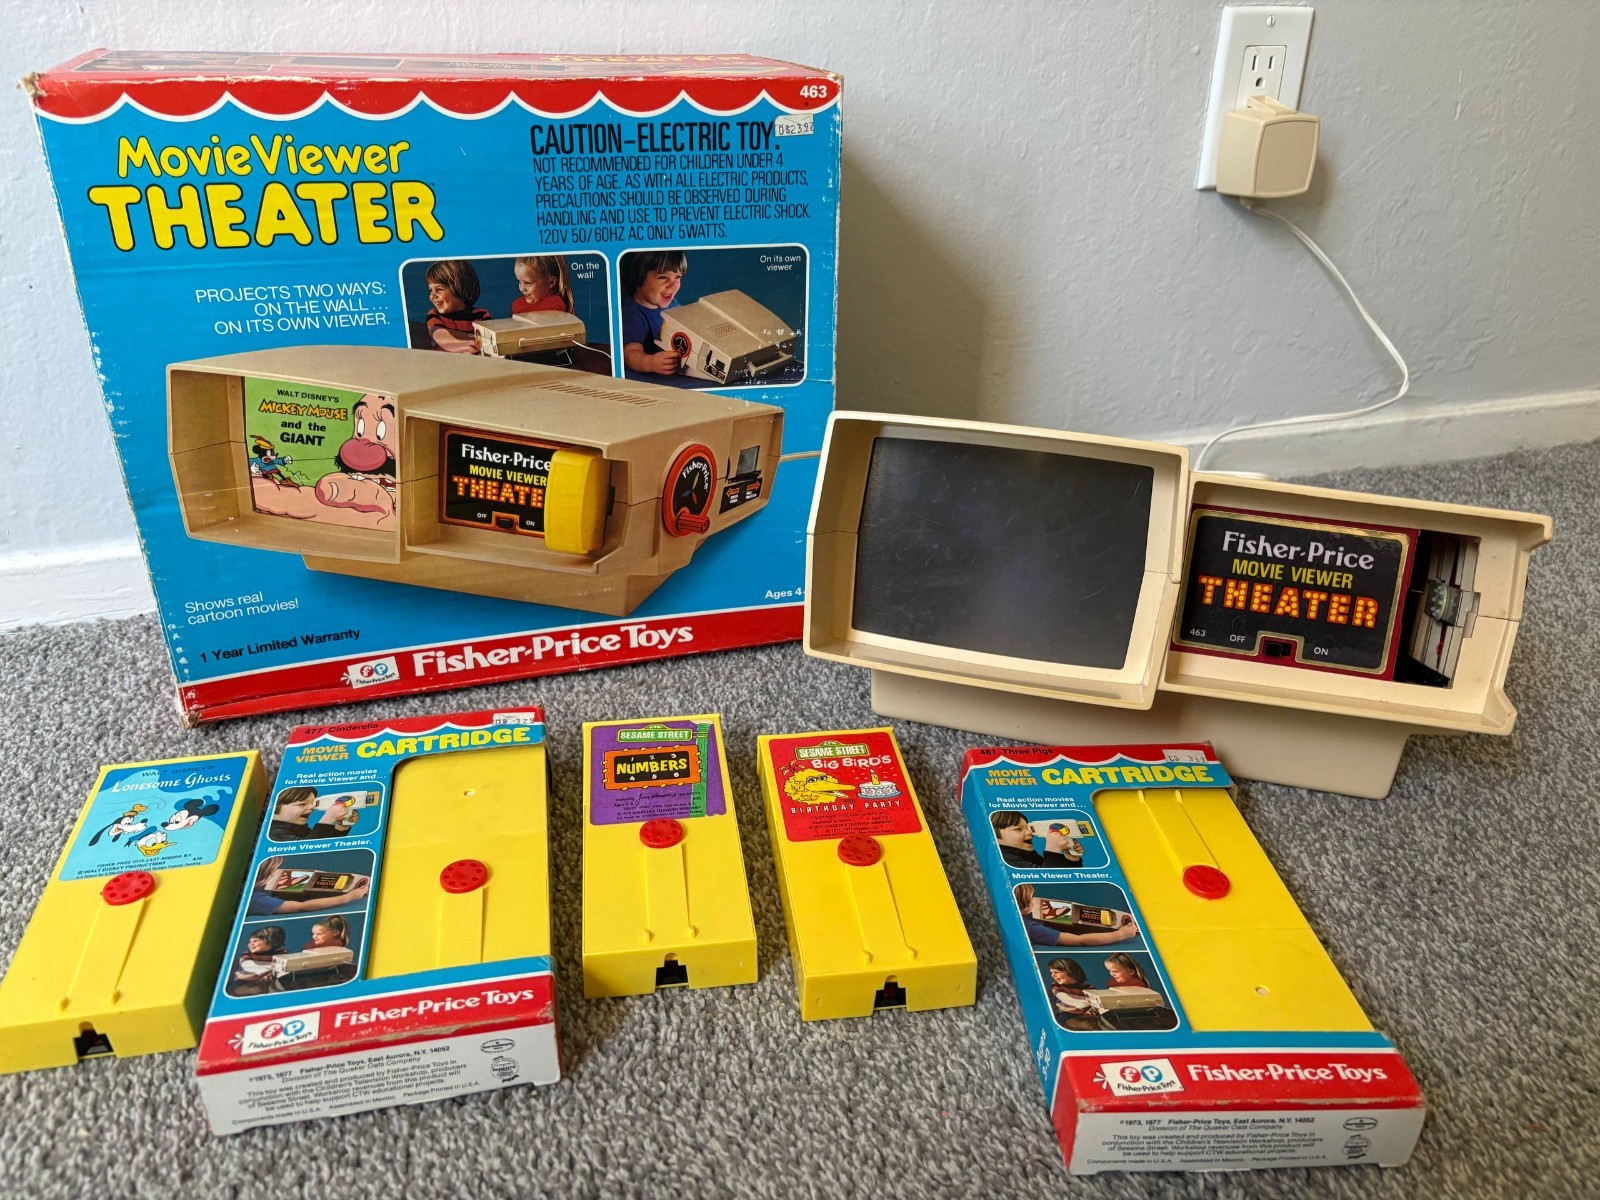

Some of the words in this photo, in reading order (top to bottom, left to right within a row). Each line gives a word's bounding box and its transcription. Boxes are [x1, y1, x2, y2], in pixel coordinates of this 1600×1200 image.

[800, 85, 827, 99] 463
[736, 121, 780, 151] TOY.
[533, 157, 556, 173] NOT
[561, 156, 651, 173] RECOMMENDED
[655, 155, 676, 171] FOR
[680, 153, 733, 170] CHILDREN
[737, 153, 773, 168] UNDER
[776, 152, 783, 168] 4
[535, 175, 574, 192] YEARS
[578, 175, 593, 191] OF
[596, 174, 621, 190] AGE.
[625, 173, 640, 189] AS
[643, 172, 672, 188] WITH
[676, 172, 695, 188] ALL
[699, 171, 748, 187] ELECTRIC
[751, 170, 808, 187] PRODUCTS,
[535, 191, 616, 210] PRECAUTIONS
[620, 190, 664, 207] SHOULD
[668, 189, 681, 205] BE
[684, 188, 740, 205] OBSERVED
[745, 187, 786, 203] DURING
[88, 180, 445, 252] THEATER
[537, 210, 596, 227] HANDLING
[600, 208, 625, 224] AND
[628, 207, 650, 223] USE
[653, 207, 666, 222] TO
[671, 205, 720, 222] PREVENT
[724, 204, 771, 220] ELECTRIC
[774, 203, 811, 219] SHOCK.
[538, 228, 567, 244] 120V
[572, 226, 625, 244] 50/60HZ
[628, 225, 644, 241] AC
[647, 224, 675, 240] ONLY
[571, 262, 584, 271] On
[585, 261, 600, 271] the
[760, 255, 772, 263] On
[773, 254, 783, 263] its
[784, 254, 801, 262] own
[766, 263, 793, 272] viewer
[577, 271, 594, 280] wall
[195, 285, 290, 303] PROJECTS
[293, 283, 333, 299] TWO
[336, 281, 387, 296] WAYS:
[254, 302, 281, 317] ON
[285, 300, 320, 315] THE
[214, 320, 242, 335] ON
[246, 318, 274, 333] ITS
[277, 316, 320, 331] OWN
[323, 312, 390, 329] VIEWER.
[277, 389, 300, 399] WALT
[301, 392, 340, 403] DISNEY'S
[258, 398, 308, 416] MICKEY
[307, 404, 348, 421] MOUSE
[281, 420, 302, 430] and
[308, 422, 326, 432] the
[280, 432, 325, 447] GIANT
[461, 443, 551, 471] Fisher-Price
[469, 464, 503, 480] MOVIE
[506, 470, 547, 487] VIEWER
[1222, 530, 1374, 570] Fisher-Price
[1231, 558, 1284, 580] MOVIE
[1291, 567, 1354, 589] VIEWER
[185, 598, 234, 614] Shows
[238, 590, 263, 605] real
[765, 590, 793, 600] Ages
[1198, 574, 1379, 629] THEATER
[188, 610, 243, 625] cartoon
[247, 598, 299, 617] movies!
[200, 652, 207, 663] 1
[211, 646, 243, 662] Year
[247, 637, 298, 655] Limited
[300, 629, 360, 647] Warranty
[413, 632, 622, 677] Fisher-Price
[620, 622, 694, 649] Toys
[1190, 628, 1206, 637] 463
[1230, 634, 1246, 643] OFF
[1314, 647, 1328, 656] ON
[305, 727, 322, 735] 477
[328, 722, 379, 733] Cinderella
[620, 730, 655, 740] SESAME
[658, 729, 690, 739] STREET
[303, 744, 348, 755] MOVIE
[356, 727, 531, 759] CARTRIDGE
[799, 747, 834, 758] SESAME
[836, 745, 867, 755] STREET
[1002, 748, 1031, 756] Three
[1032, 747, 1054, 757] Pigs
[295, 752, 349, 764] VIEWER
[616, 758, 688, 775] NUMBERS
[111, 780, 181, 793] Lonesome
[184, 772, 231, 788] Ghosts
[318, 770, 345, 778] action
[328, 775, 358, 783] Viewer
[984, 777, 1038, 786] VIEWER
[988, 769, 1031, 778] MOVIE
[1041, 765, 1215, 786] CARTRIDGE
[791, 803, 855, 815] BIRTHDAY
[864, 800, 901, 809] PARTY
[300, 843, 331, 851] Viewer
[334, 840, 373, 848] Theater.
[334, 997, 480, 1028] Fisher-Price
[481, 988, 535, 1006] Toys
[1187, 1064, 1337, 1082] Fisher-Price
[1336, 1064, 1387, 1081] Toys
